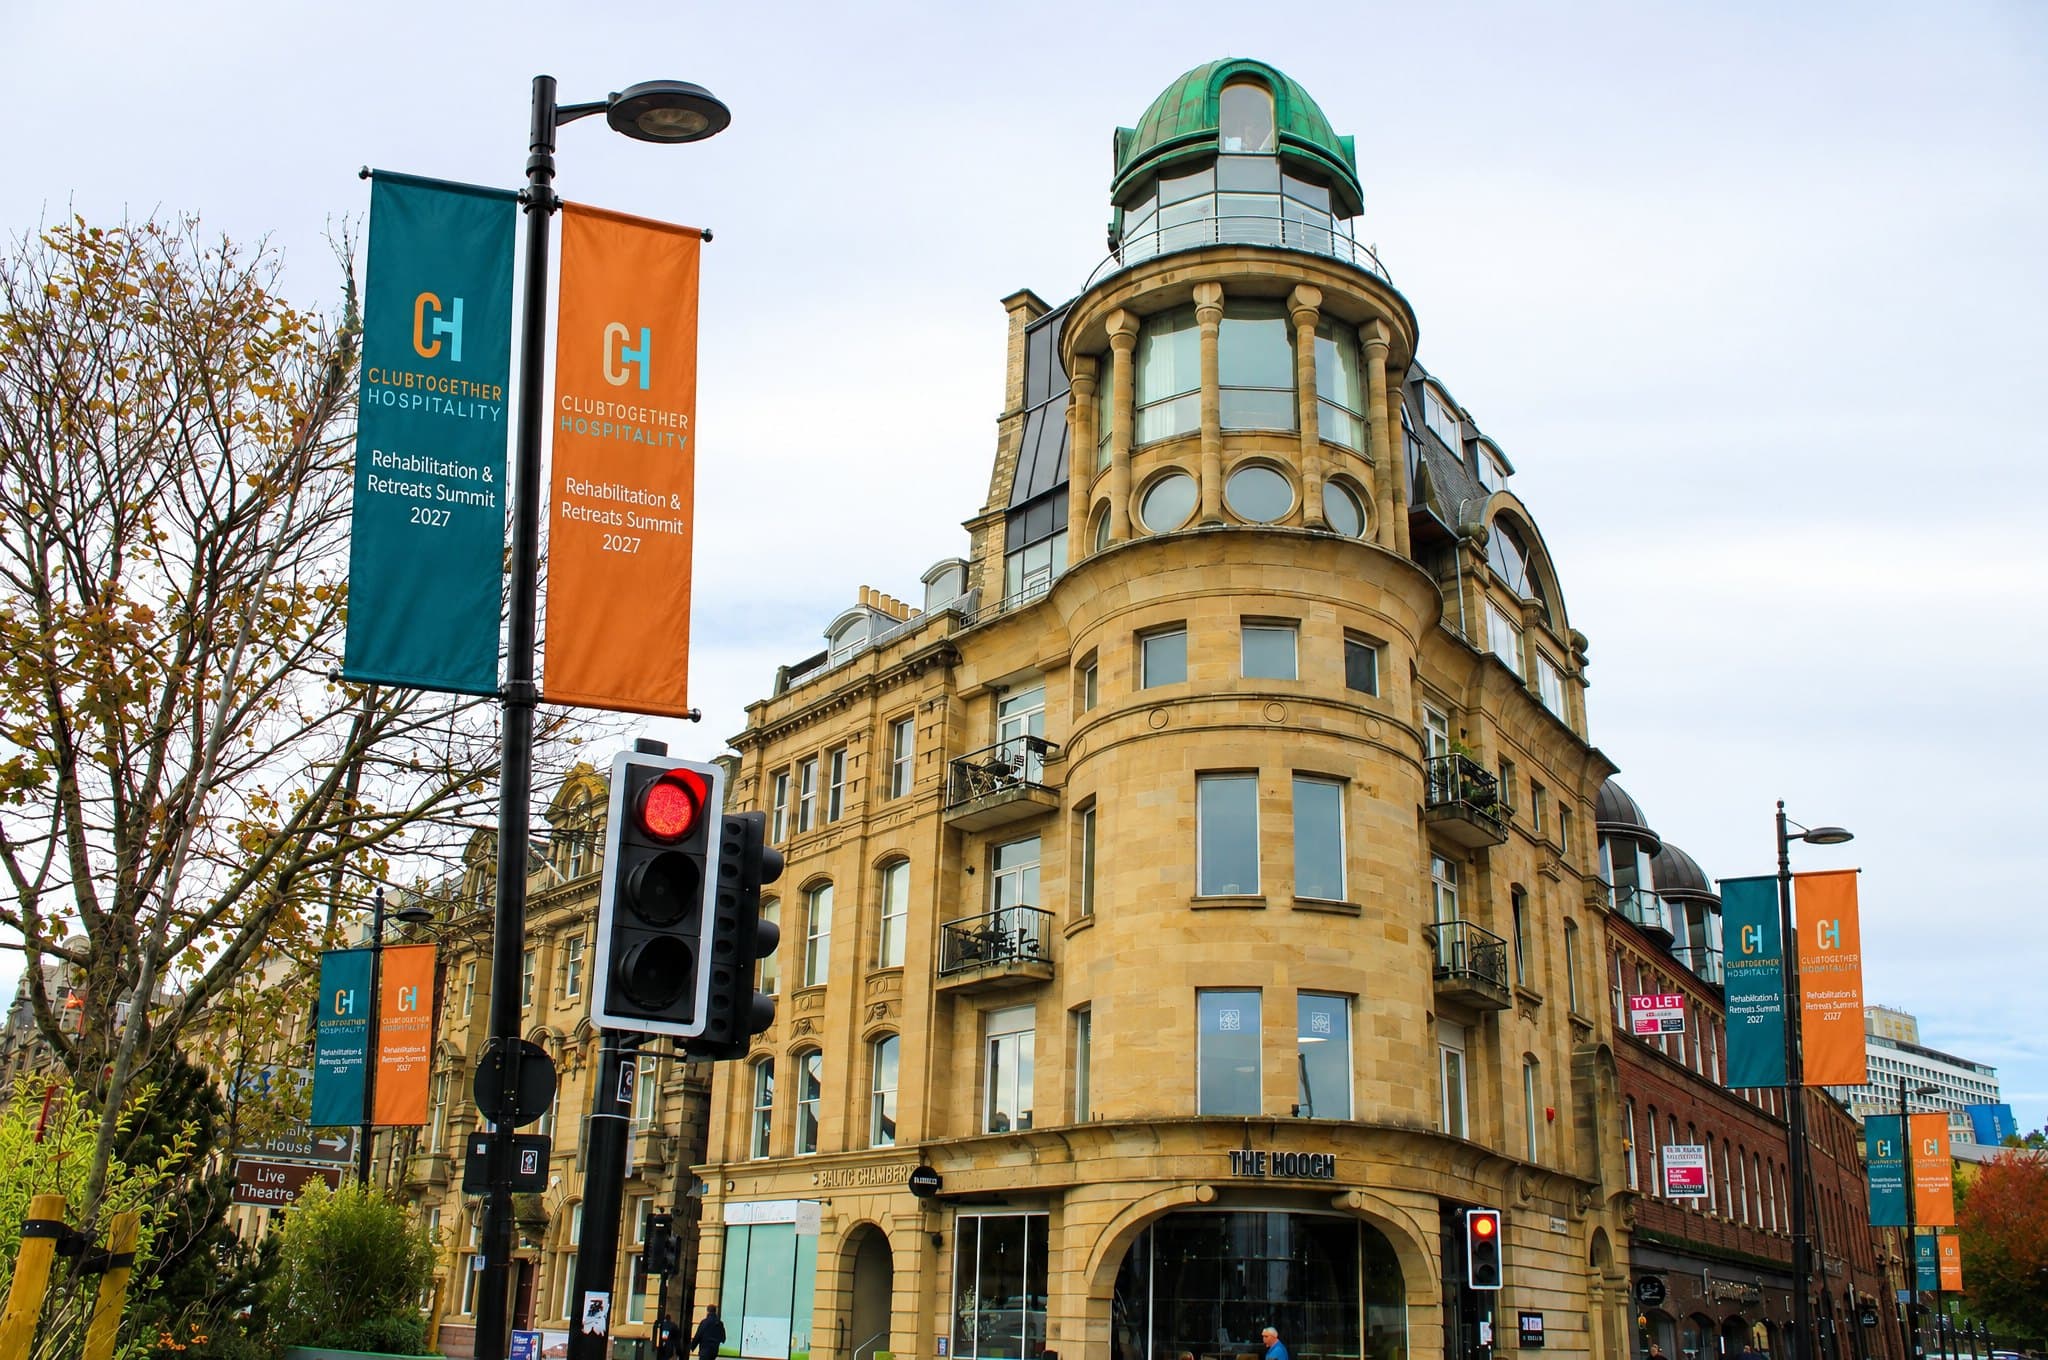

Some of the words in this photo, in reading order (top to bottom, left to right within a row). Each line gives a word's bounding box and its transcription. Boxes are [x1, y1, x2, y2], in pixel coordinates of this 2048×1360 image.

[413, 291, 464, 362] CH
[603, 321, 652, 390] CH
[368, 367, 502, 401] CLUBTOGETHER
[368, 388, 501, 422] HOSPITALITY
[561, 395, 689, 430] CLUBTOGETHER
[560, 415, 687, 450] HOSPITALITY
[372, 449, 478, 481] Rehabilitation
[482, 465, 494, 483] &
[367, 474, 432, 499] Retreats
[436, 483, 496, 508] Summit
[566, 477, 666, 508] Rehabilitation
[670, 493, 681, 510] &
[410, 506, 451, 527] 2027
[561, 501, 623, 526] Retreats
[626, 511, 684, 535] Summit
[602, 533, 641, 554] 2027
[1741, 924, 1763, 955] CH
[1816, 918, 1840, 950] CH
[1727, 968, 1780, 977] HOSPITALITY
[1801, 954, 1858, 965] CLUBTOGETHER
[335, 989, 354, 1015] CH
[398, 986, 417, 1012] CH
[1631, 996, 1652, 1009] TO
[1655, 995, 1682, 1008] LET
[1730, 993, 1773, 1003] Rehabilitation
[1773, 993, 1779, 1001] &
[1755, 1004, 1781, 1013] Summit
[1746, 1015, 1764, 1024] 2027
[266, 1137, 313, 1154] House
[257, 1168, 286, 1183] Live
[1228, 1150, 1267, 1176] THE
[1271, 1151, 1337, 1178] HOOCH
[822, 1168, 855, 1187] BALTIC
[240, 1183, 294, 1200] Theatre
